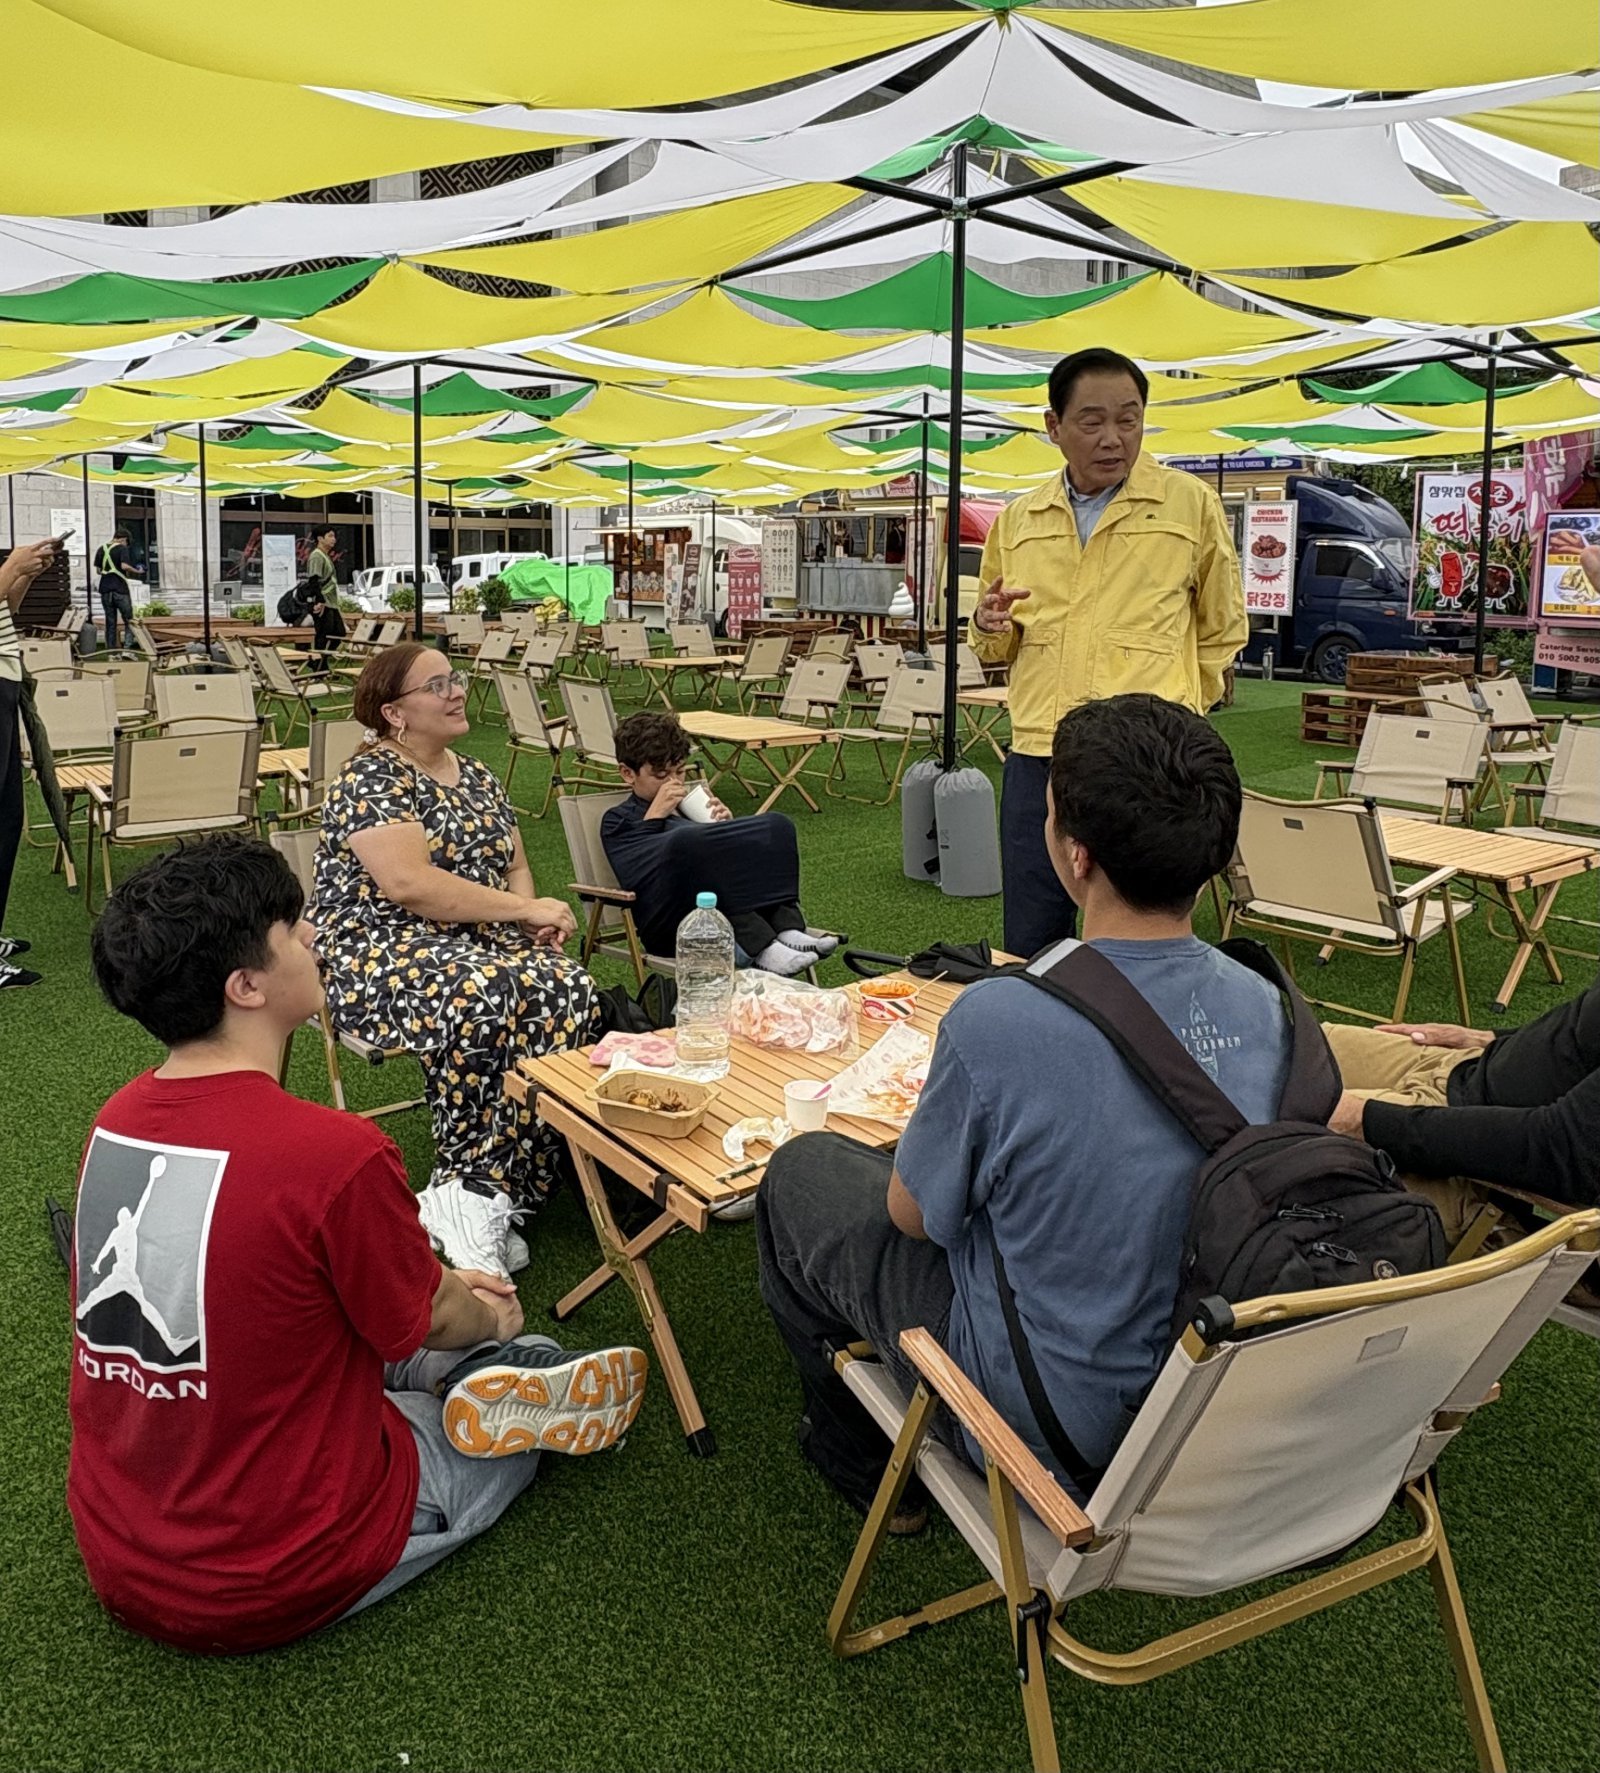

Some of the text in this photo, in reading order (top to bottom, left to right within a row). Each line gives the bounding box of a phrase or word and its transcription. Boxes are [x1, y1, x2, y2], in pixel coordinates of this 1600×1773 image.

[1244, 460, 1265, 468] CHICKEN
[1247, 592, 1286, 608] 닭강정
[1539, 643, 1573, 652] Catering
[1538, 652, 1555, 660] 010
[1558, 654, 1580, 662] 5002
[1181, 1024, 1218, 1040] PLAYA
[1196, 1036, 1241, 1052] CARMEN
[78, 1348, 207, 1400] JORDAN
